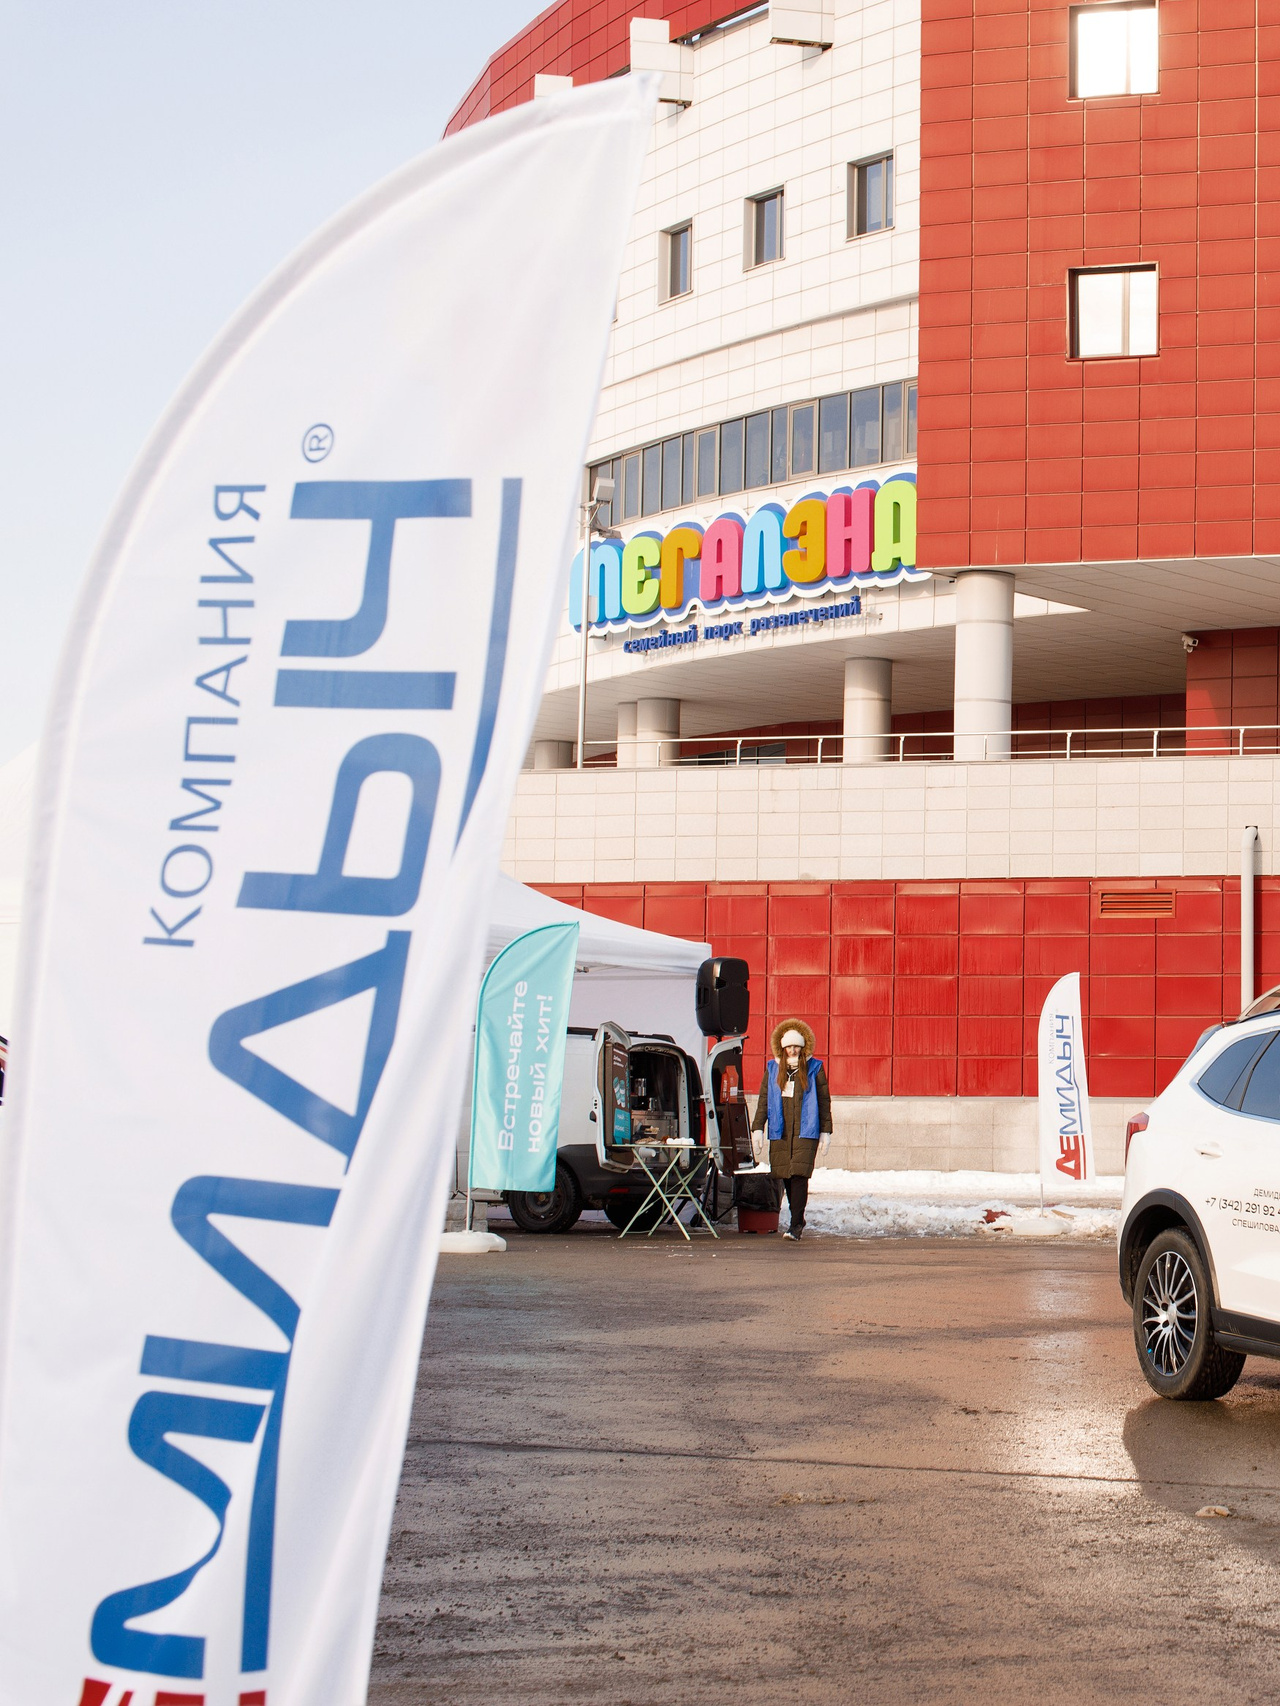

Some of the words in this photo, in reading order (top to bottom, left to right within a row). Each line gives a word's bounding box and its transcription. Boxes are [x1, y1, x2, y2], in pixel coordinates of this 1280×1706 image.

[569, 480, 917, 626] МЕГАЛЭНД
[623, 624, 698, 653] семейный
[703, 620, 743, 640] парк
[750, 595, 861, 636] развлечений
[143, 484, 266, 947] КОМПАНИЯ
[498, 980, 528, 1151] Встречайте
[536, 994, 553, 1052] хит!
[80, 478, 472, 1706] МИДЫЧ
[528, 1063, 546, 1152] новый
[1055, 1014, 1081, 1180] ДЕМИДЫЧ
[1205, 1197, 1217, 1207] +7
[1218, 1198, 1243, 1213] (342)
[1245, 1202, 1261, 1214] 291
[1263, 1205, 1275, 1217] 92
[1231, 1218, 1280, 1234] СПЕШИЛОВА,
